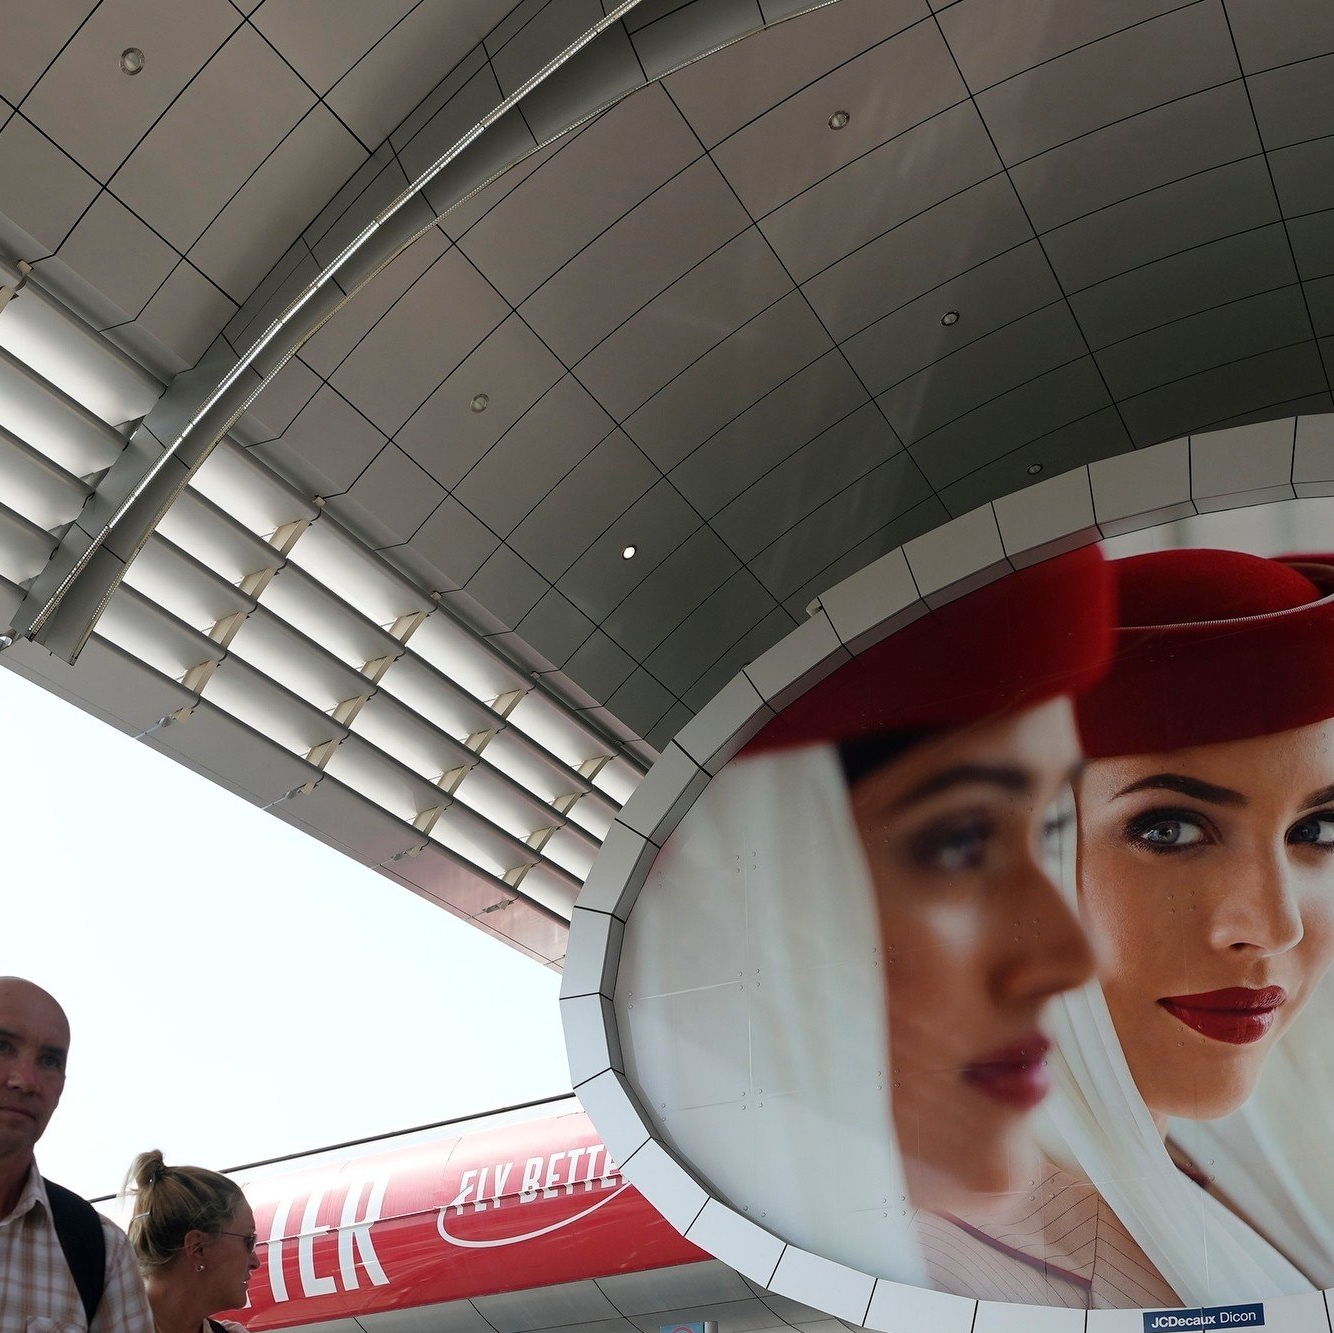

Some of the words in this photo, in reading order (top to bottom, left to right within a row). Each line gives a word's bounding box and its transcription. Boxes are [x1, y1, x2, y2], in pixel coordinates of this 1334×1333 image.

[451, 1162, 514, 1216] FLY
[519, 1143, 630, 1204] BETTE
[1151, 1315, 1216, 1328] JCDecaux
[1219, 1311, 1257, 1324] Dicon
